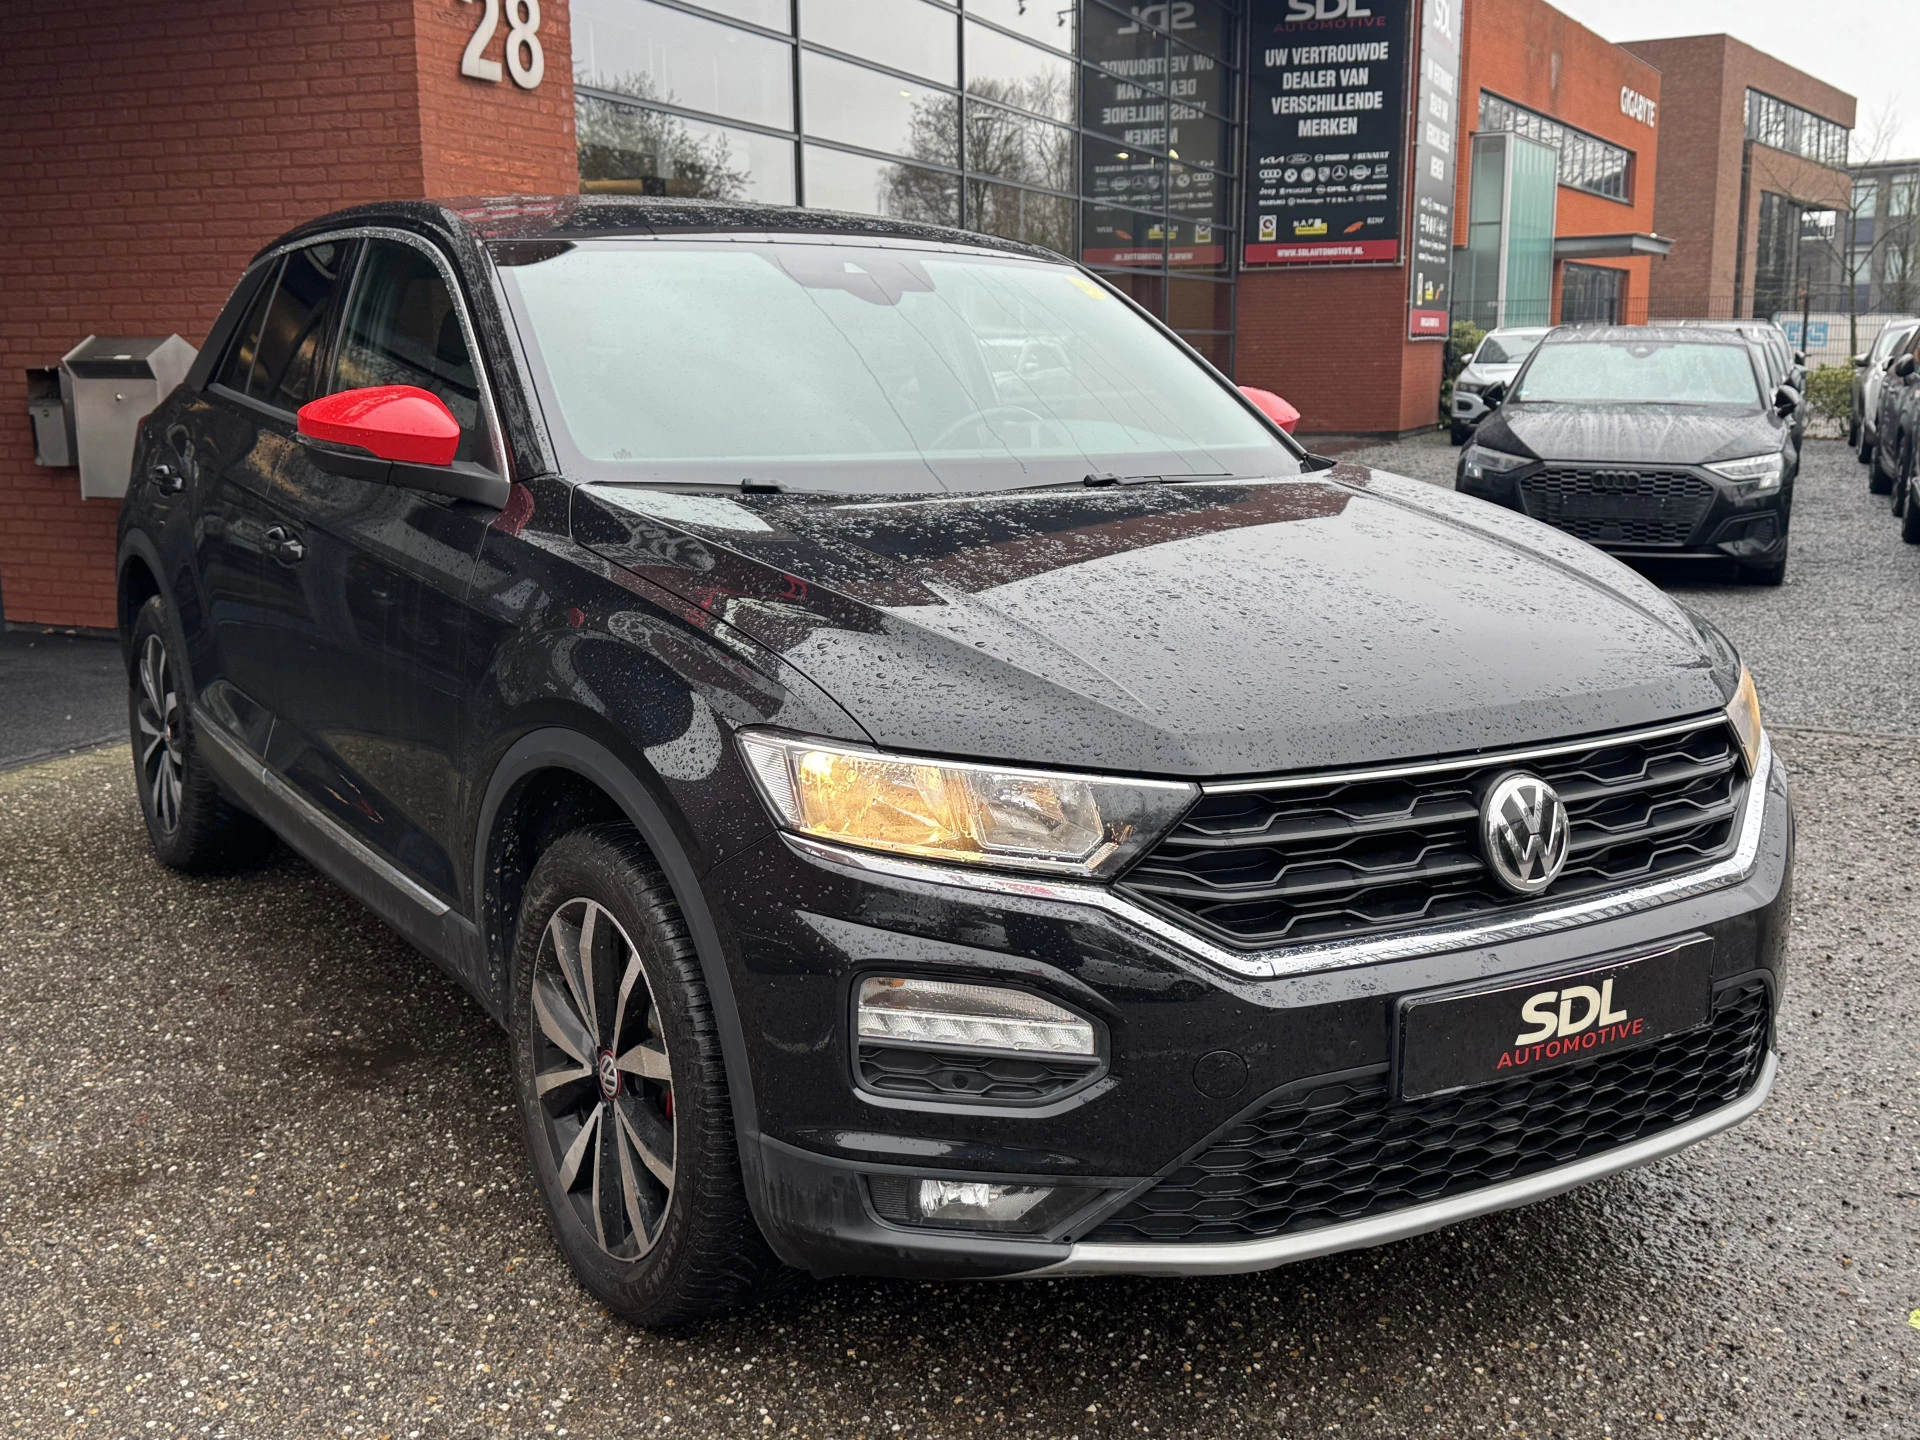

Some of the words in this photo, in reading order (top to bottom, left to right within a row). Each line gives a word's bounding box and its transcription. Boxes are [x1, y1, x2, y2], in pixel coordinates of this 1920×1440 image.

[1285, 0, 1372, 22] SDL
[1273, 16, 1386, 33] AUTOMOTIVE
[457, 0, 545, 90] 28
[1265, 48, 1288, 67] UW
[1292, 41, 1389, 65] VERTROUWDE
[1282, 69, 1336, 90] DEALER
[1340, 67, 1369, 87] VAN
[1271, 91, 1383, 115] VERSCHILLENDE
[1620, 85, 1657, 128] GIGABYTE
[1298, 116, 1358, 137] MERKEN
[1277, 246, 1364, 258] WWW.SDLAUTOMOTIVE.NL
[1515, 979, 1627, 1046] SDL
[1496, 1018, 1644, 1070] AUTOMOTIVE
